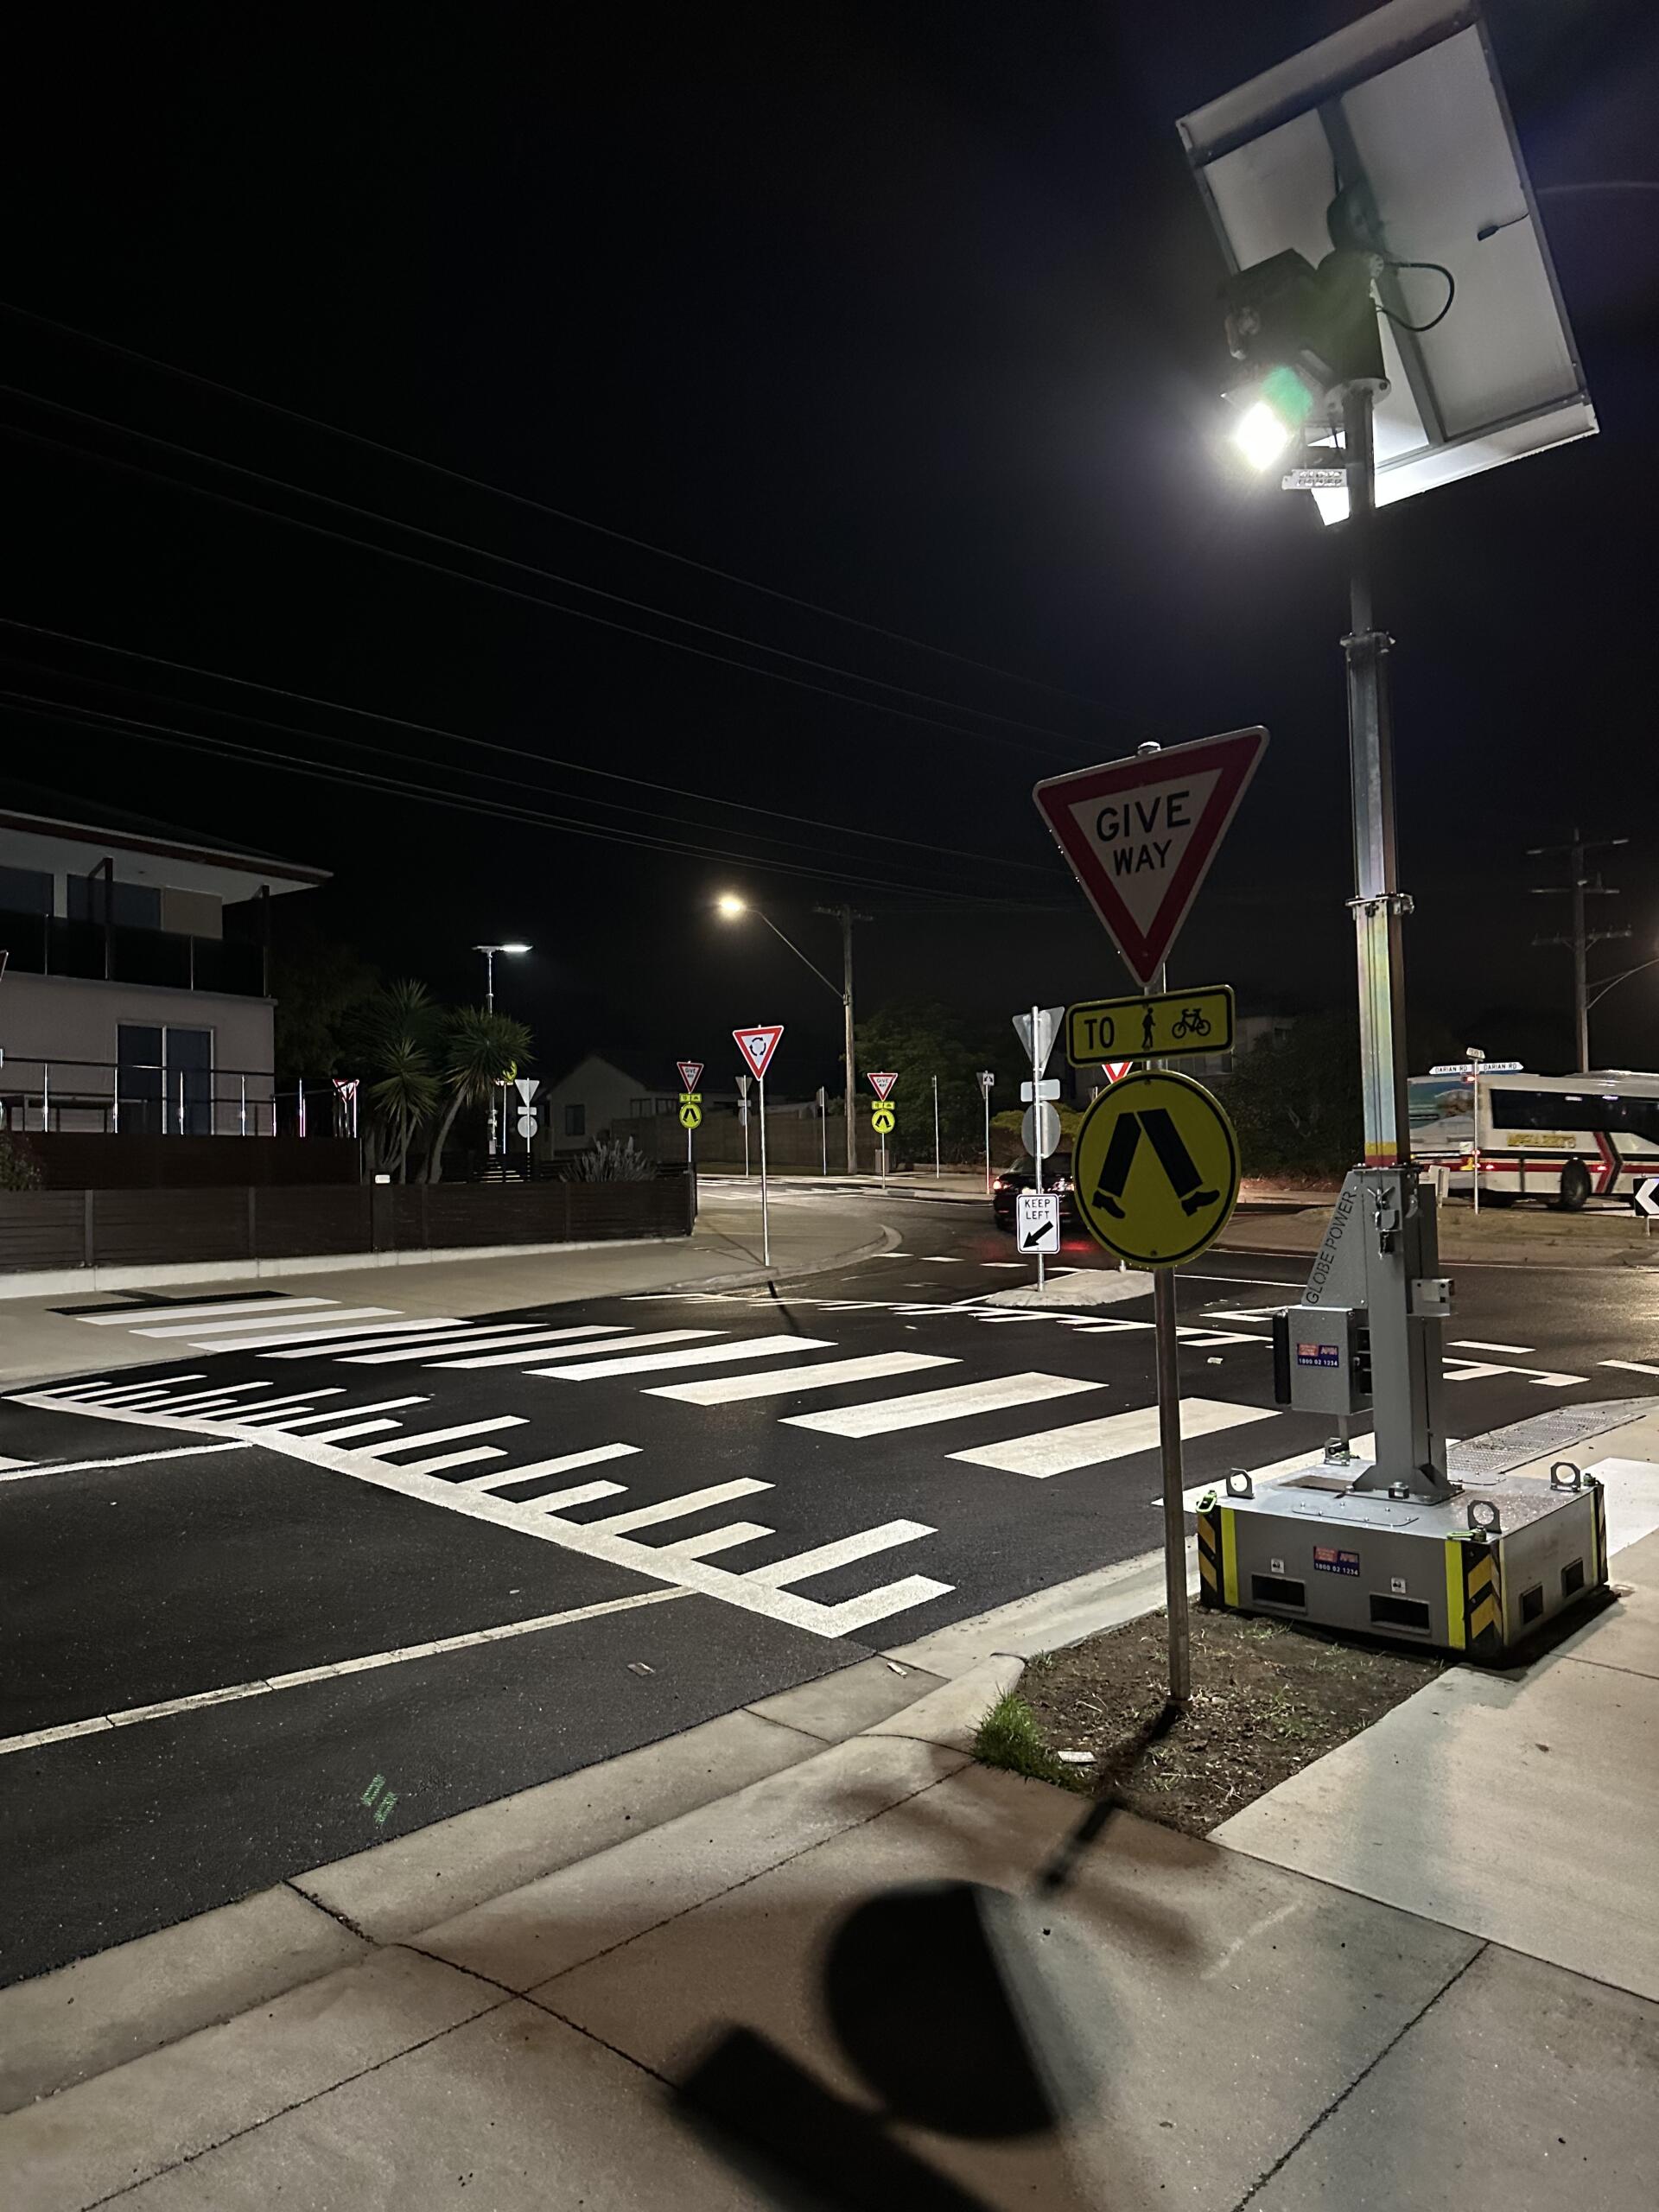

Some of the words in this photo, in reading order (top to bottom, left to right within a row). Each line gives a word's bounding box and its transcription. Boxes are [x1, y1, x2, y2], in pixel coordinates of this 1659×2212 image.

[1096, 791, 1192, 842] GIVE
[1114, 839, 1173, 876] WAY
[1084, 1016, 1115, 1050] TO
[1025, 1198, 1051, 1208] KEEP
[1026, 1211, 1050, 1220] LEFT
[1306, 1253, 1335, 1305] GLOBE
[1325, 1191, 1357, 1251] POWER
[1342, 1567, 1358, 1576] 1234
